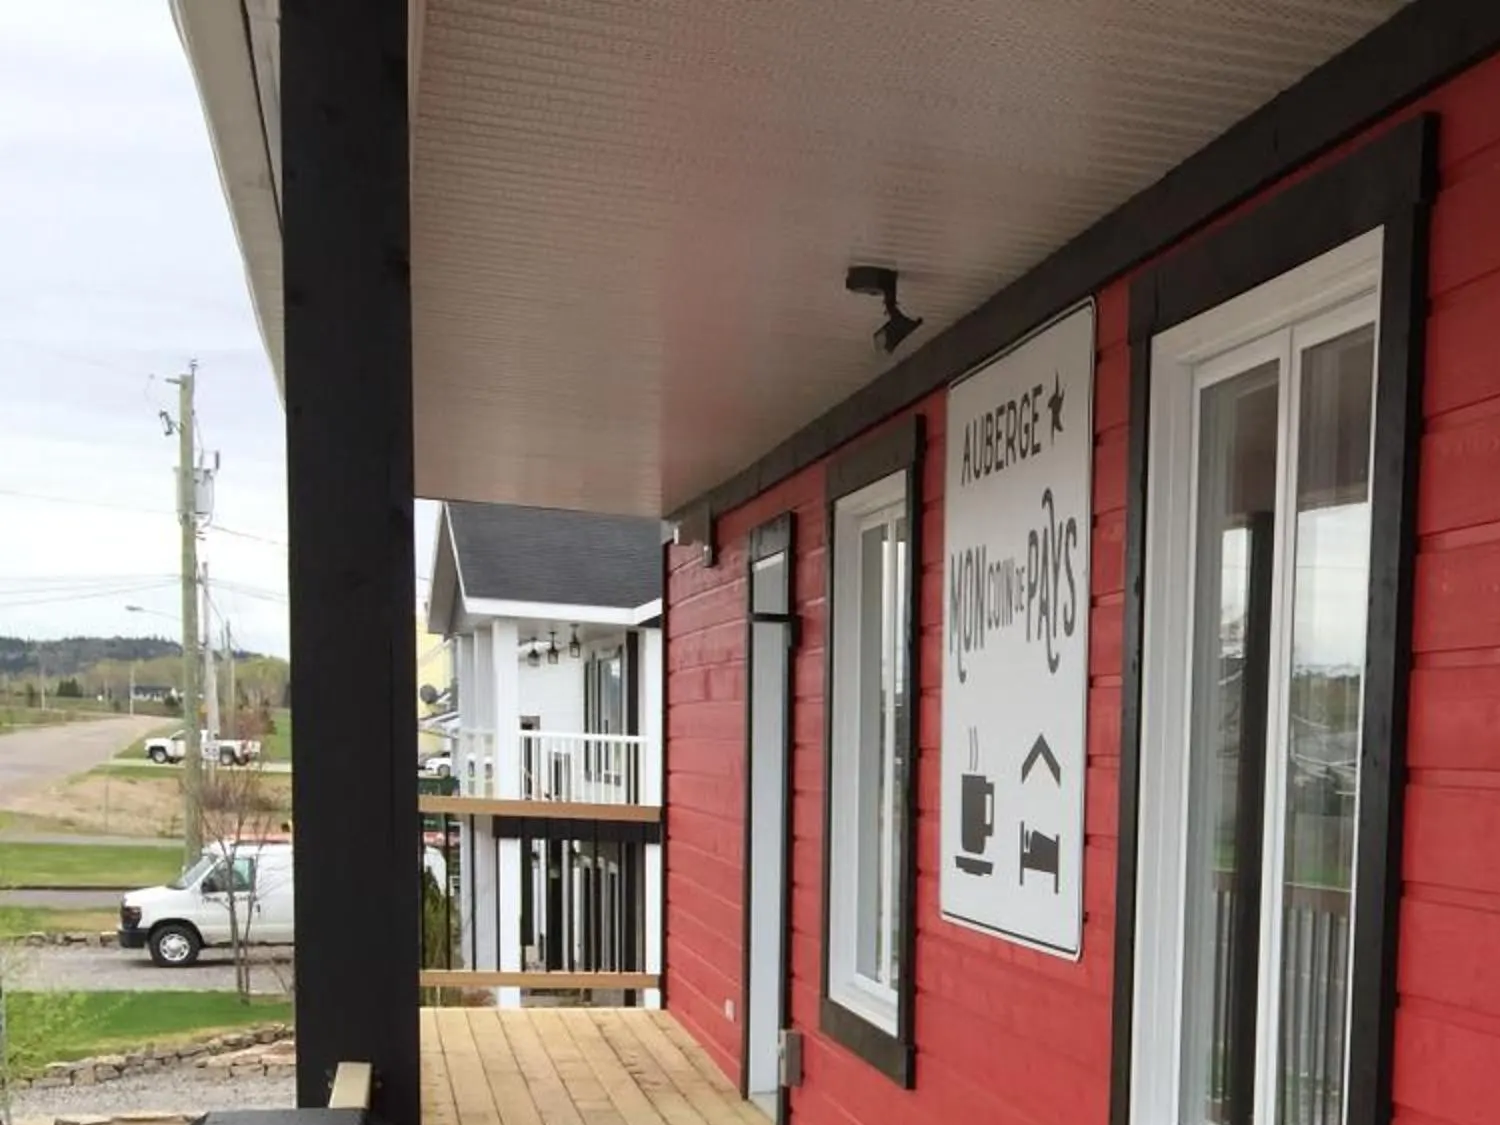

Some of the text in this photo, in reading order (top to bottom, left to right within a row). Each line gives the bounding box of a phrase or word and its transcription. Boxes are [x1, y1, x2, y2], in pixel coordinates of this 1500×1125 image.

[961, 384, 1043, 487] AUBERGE
[949, 544, 986, 684] MON
[987, 557, 1014, 631] COIN
[1026, 487, 1078, 675] PAYS
